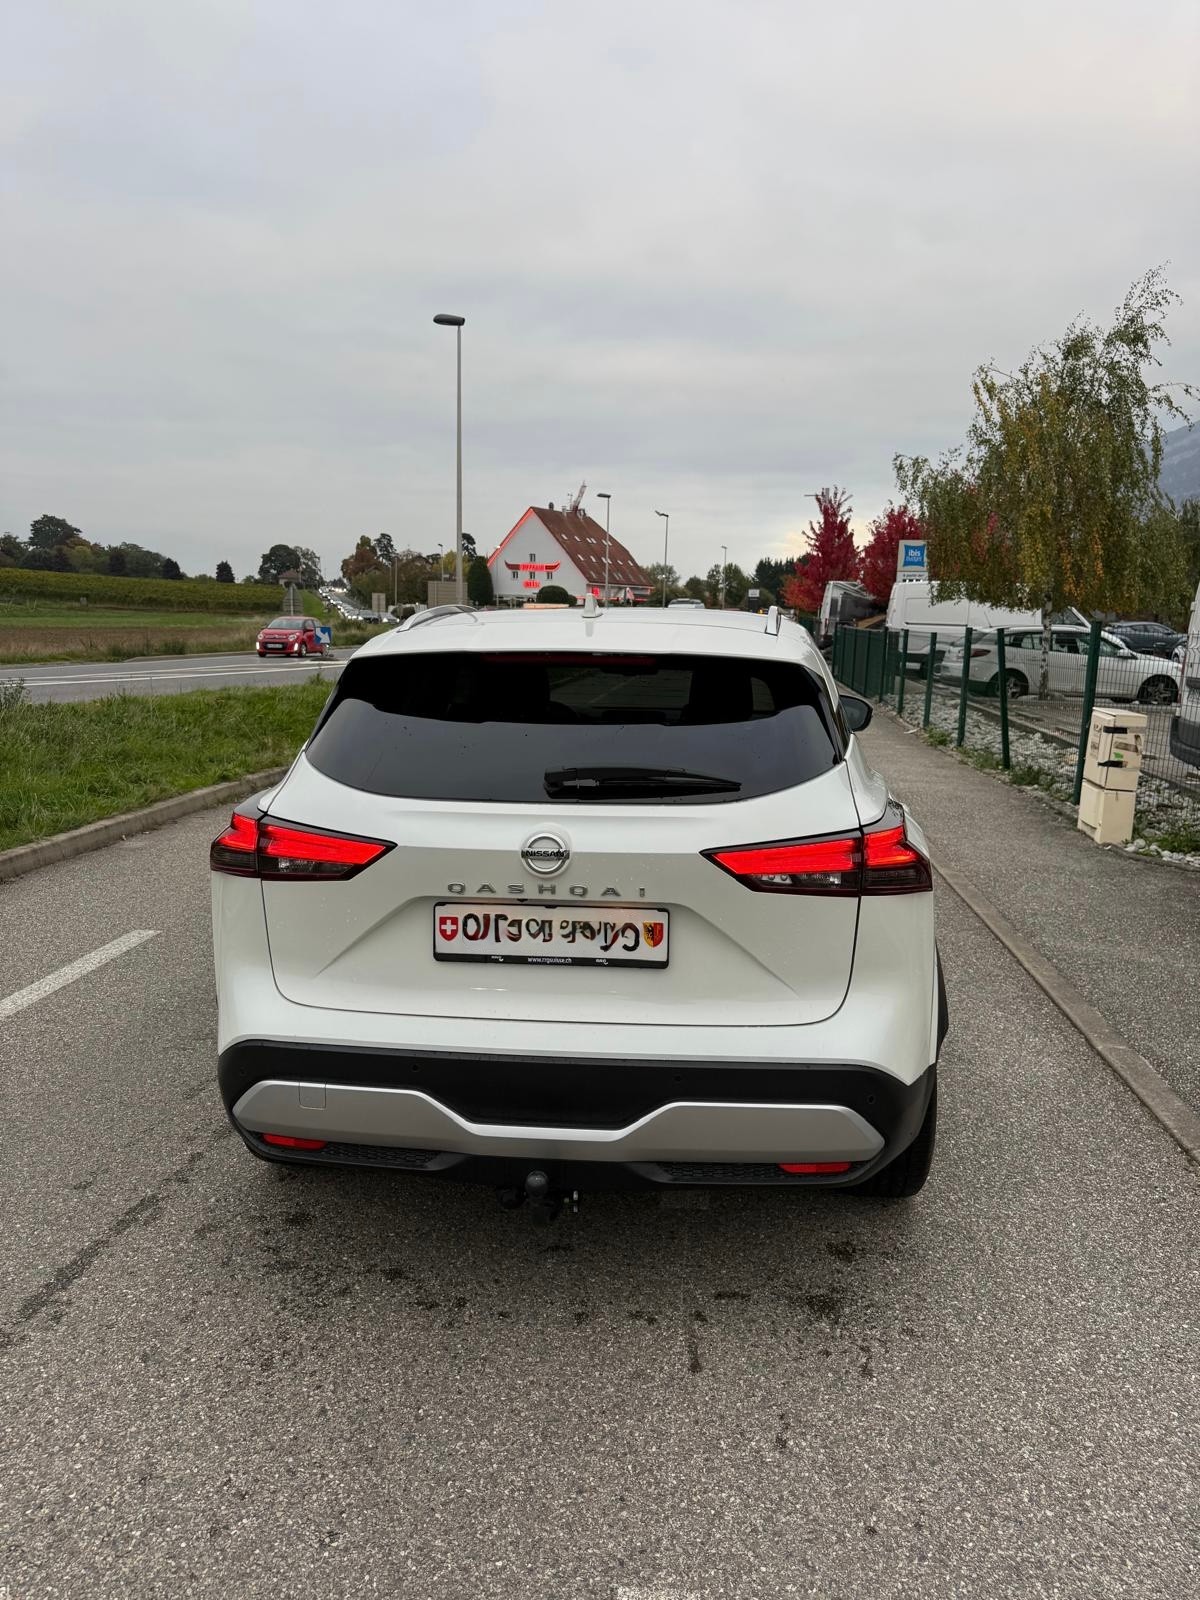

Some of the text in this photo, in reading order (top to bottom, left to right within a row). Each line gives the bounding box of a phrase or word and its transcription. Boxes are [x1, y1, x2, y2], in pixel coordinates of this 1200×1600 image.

[908, 549, 921, 557] ibis
[525, 850, 565, 858] NISSAN
[447, 882, 646, 898] QASHQAI
